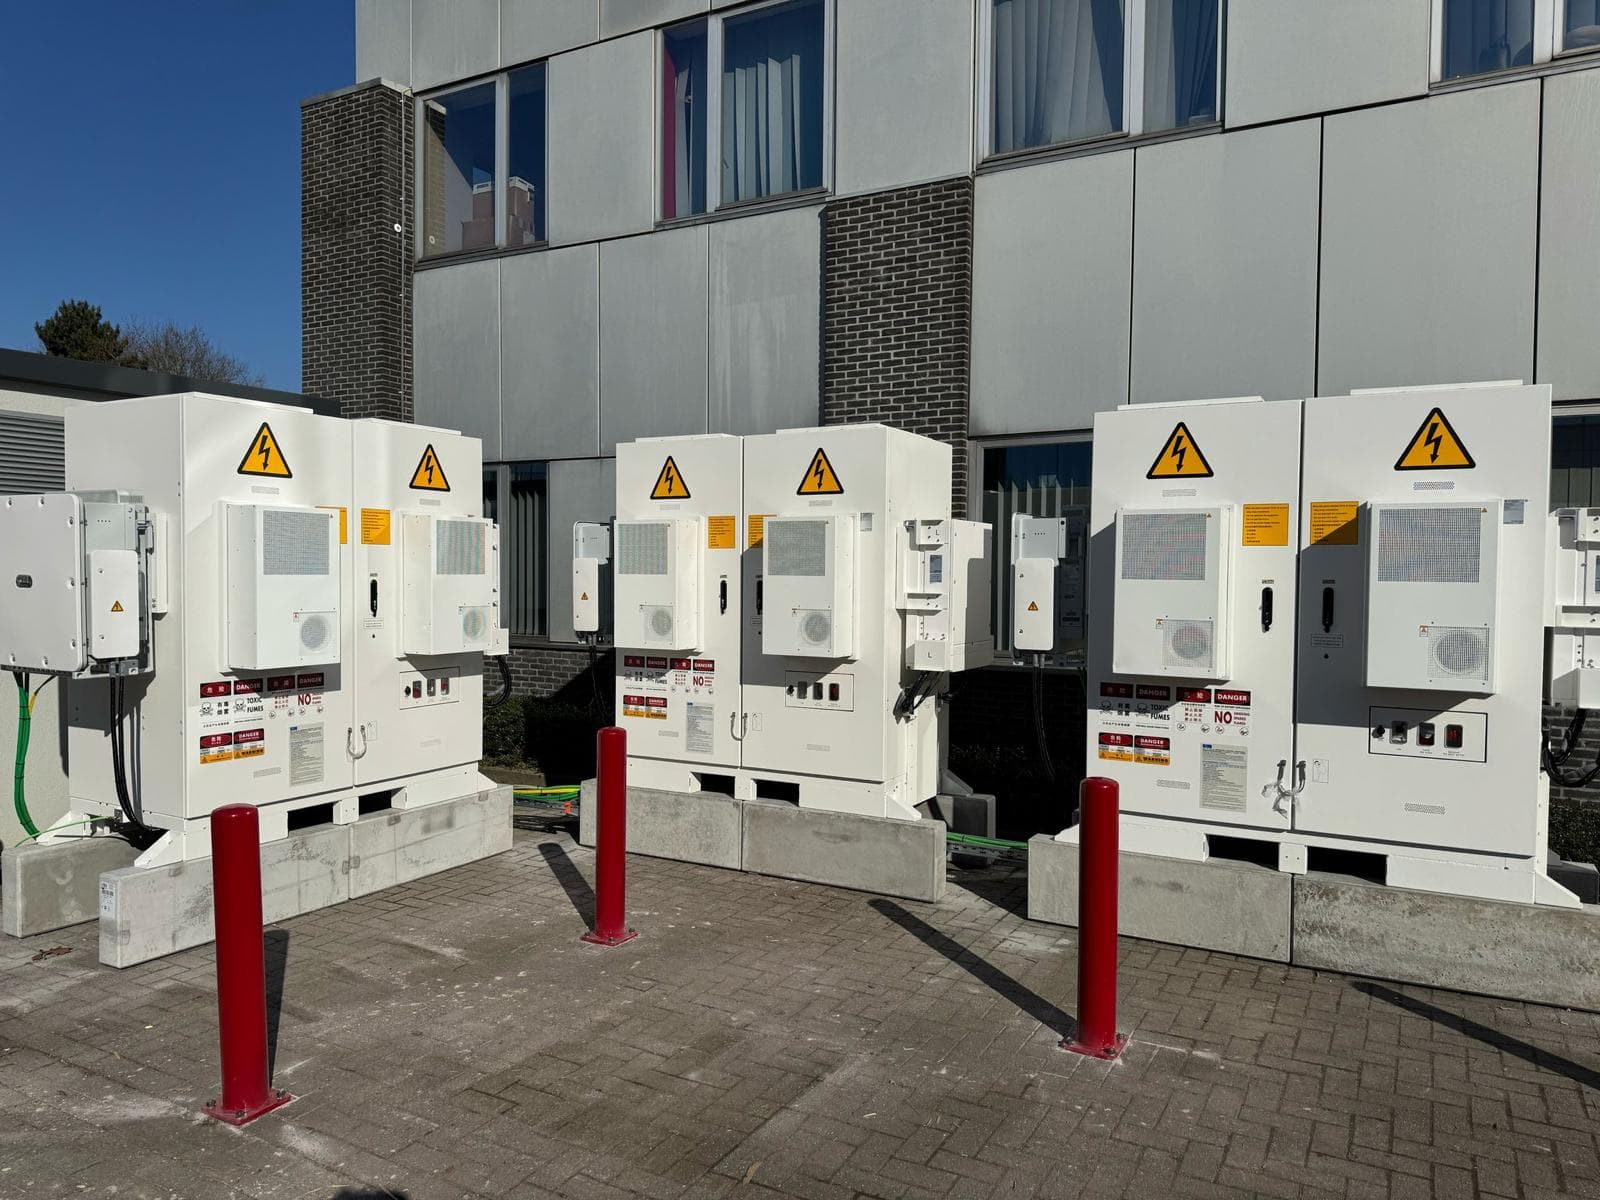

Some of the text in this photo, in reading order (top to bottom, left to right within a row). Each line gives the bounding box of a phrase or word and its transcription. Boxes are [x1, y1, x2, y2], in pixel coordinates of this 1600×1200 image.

[692, 675, 704, 686] NO
[1139, 688, 1167, 697] DANGER
[247, 697, 263, 705] TOXIC
[297, 693, 311, 706] NO
[247, 705, 264, 713] FUMES
[1150, 713, 1171, 721] FUMES
[1214, 710, 1232, 724] NO
[1140, 737, 1164, 745] DANGER
